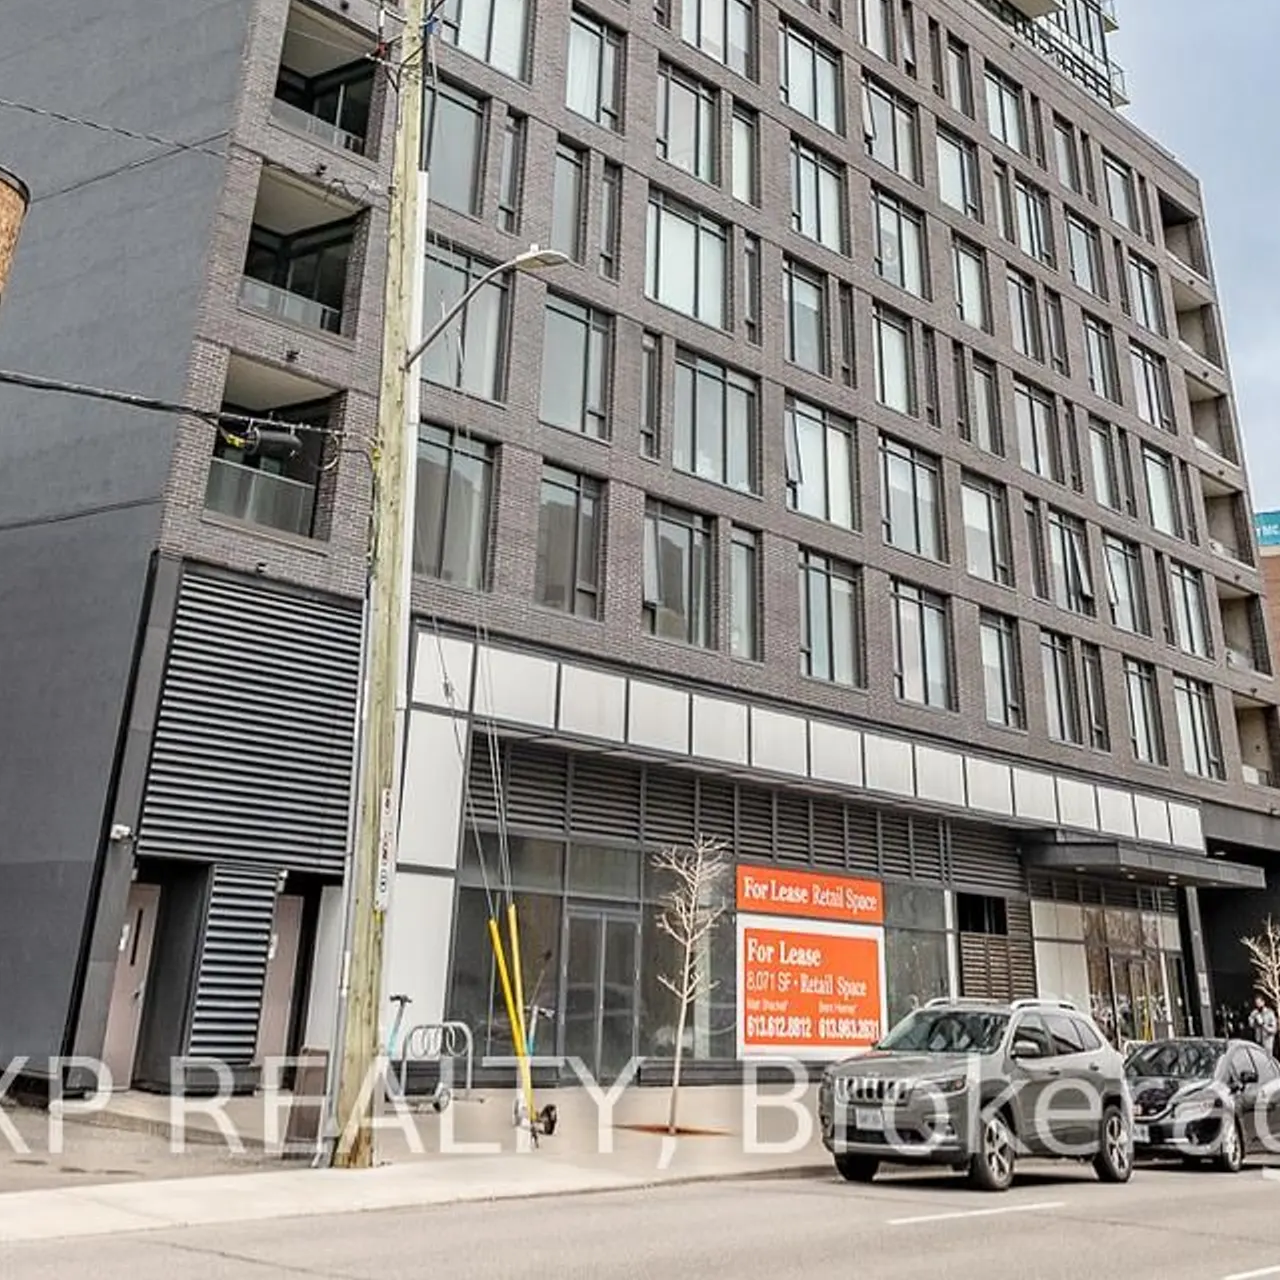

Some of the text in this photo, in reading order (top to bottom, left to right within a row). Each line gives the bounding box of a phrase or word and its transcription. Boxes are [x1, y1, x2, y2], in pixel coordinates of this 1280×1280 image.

[743, 876, 877, 914] For Lease Retail Space
[747, 937, 821, 967] For Lease
[778, 971, 792, 993] SF
[800, 973, 833, 995] Retail
[837, 976, 867, 1001] Space
